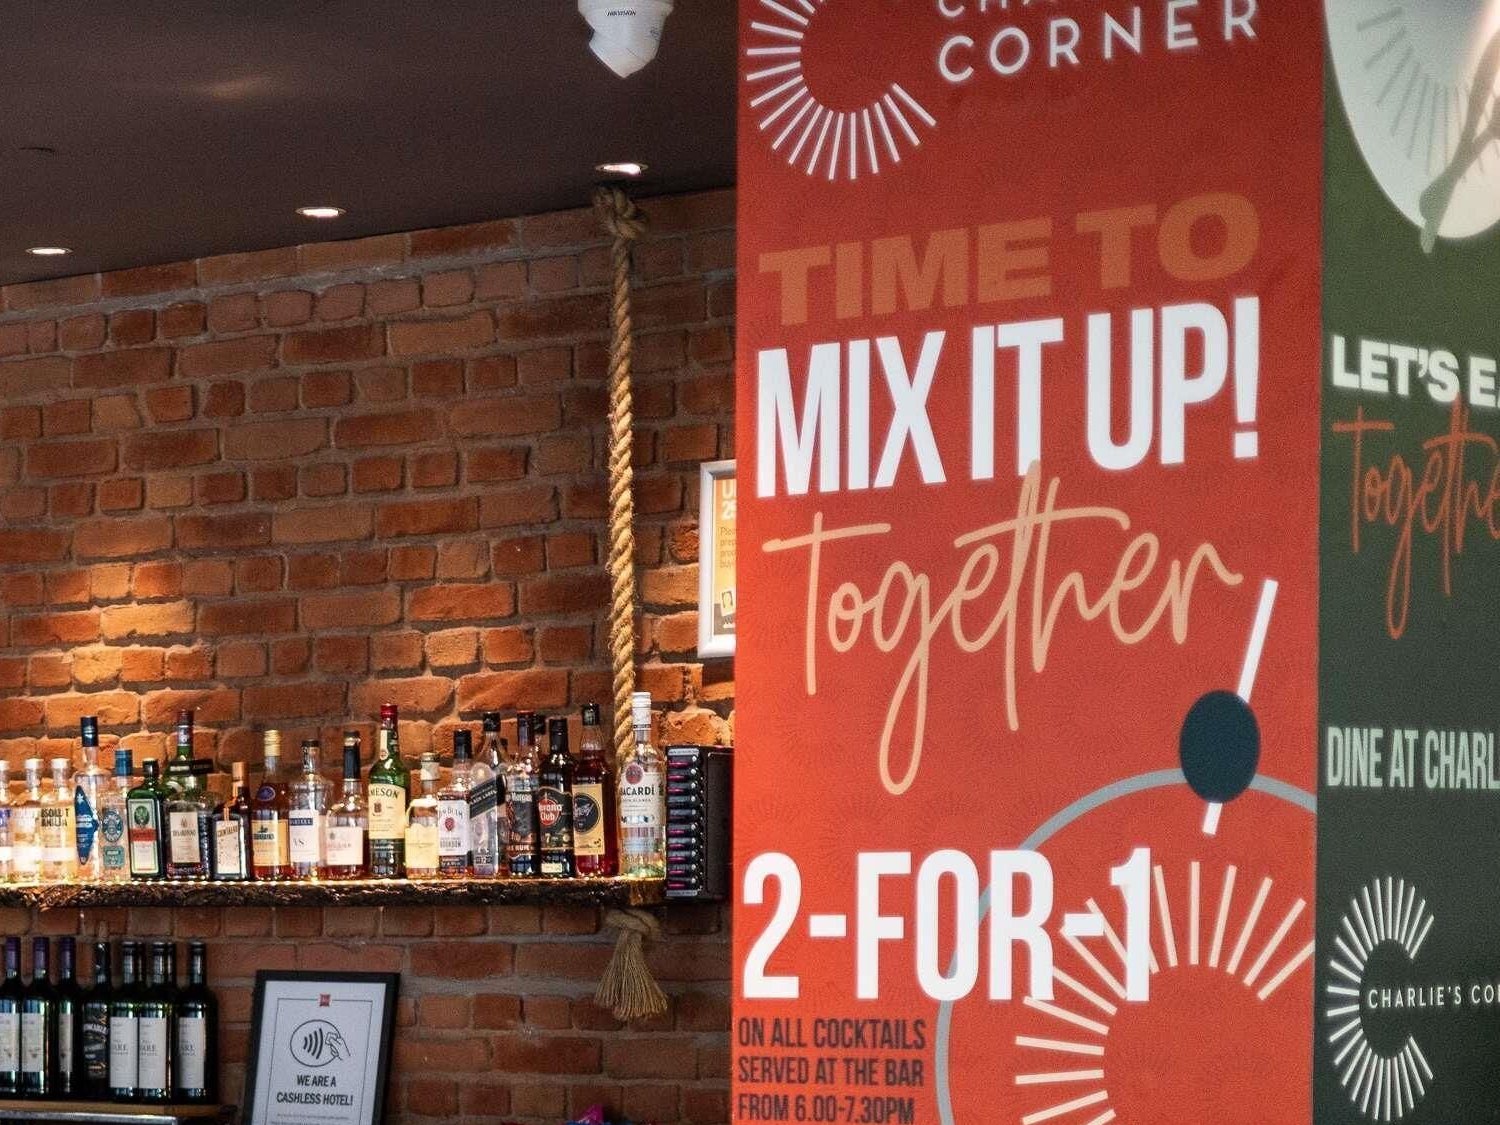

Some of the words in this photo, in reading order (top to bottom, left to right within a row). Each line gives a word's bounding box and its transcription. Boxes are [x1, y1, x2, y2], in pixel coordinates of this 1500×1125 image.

[938, 0, 1257, 82] CORNER
[758, 217, 1054, 326] TIME
[1075, 193, 1261, 289] TO
[756, 330, 947, 498] MIX
[971, 318, 1064, 481] IT
[1086, 296, 1261, 472] UP!
[1332, 334, 1461, 403] LET'S
[1469, 356, 1500, 409] E
[762, 460, 1245, 796] Together
[1327, 726, 1384, 787] DINE
[1389, 729, 1419, 788] AT
[743, 847, 1151, 1001] 2-FOR-1
[1368, 985, 1462, 1009] CHARLIE'S
[738, 1017, 765, 1047] ON
[771, 1018, 808, 1048] ALL
[813, 1018, 927, 1050] COCKTAILS
[277, 1092, 322, 1105] CASHLESS
[322, 1094, 353, 1106] HOTEL!
[297, 1074, 310, 1086] WE
[311, 1075, 330, 1088] ARE
[330, 1076, 337, 1088] A
[738, 1056, 809, 1085] SERVED
[814, 1058, 838, 1085] AT
[843, 1058, 879, 1086] THE
[884, 1058, 925, 1087] BAR
[738, 1093, 789, 1121] FROM
[794, 1094, 915, 1125] 6.00-7.30PM
